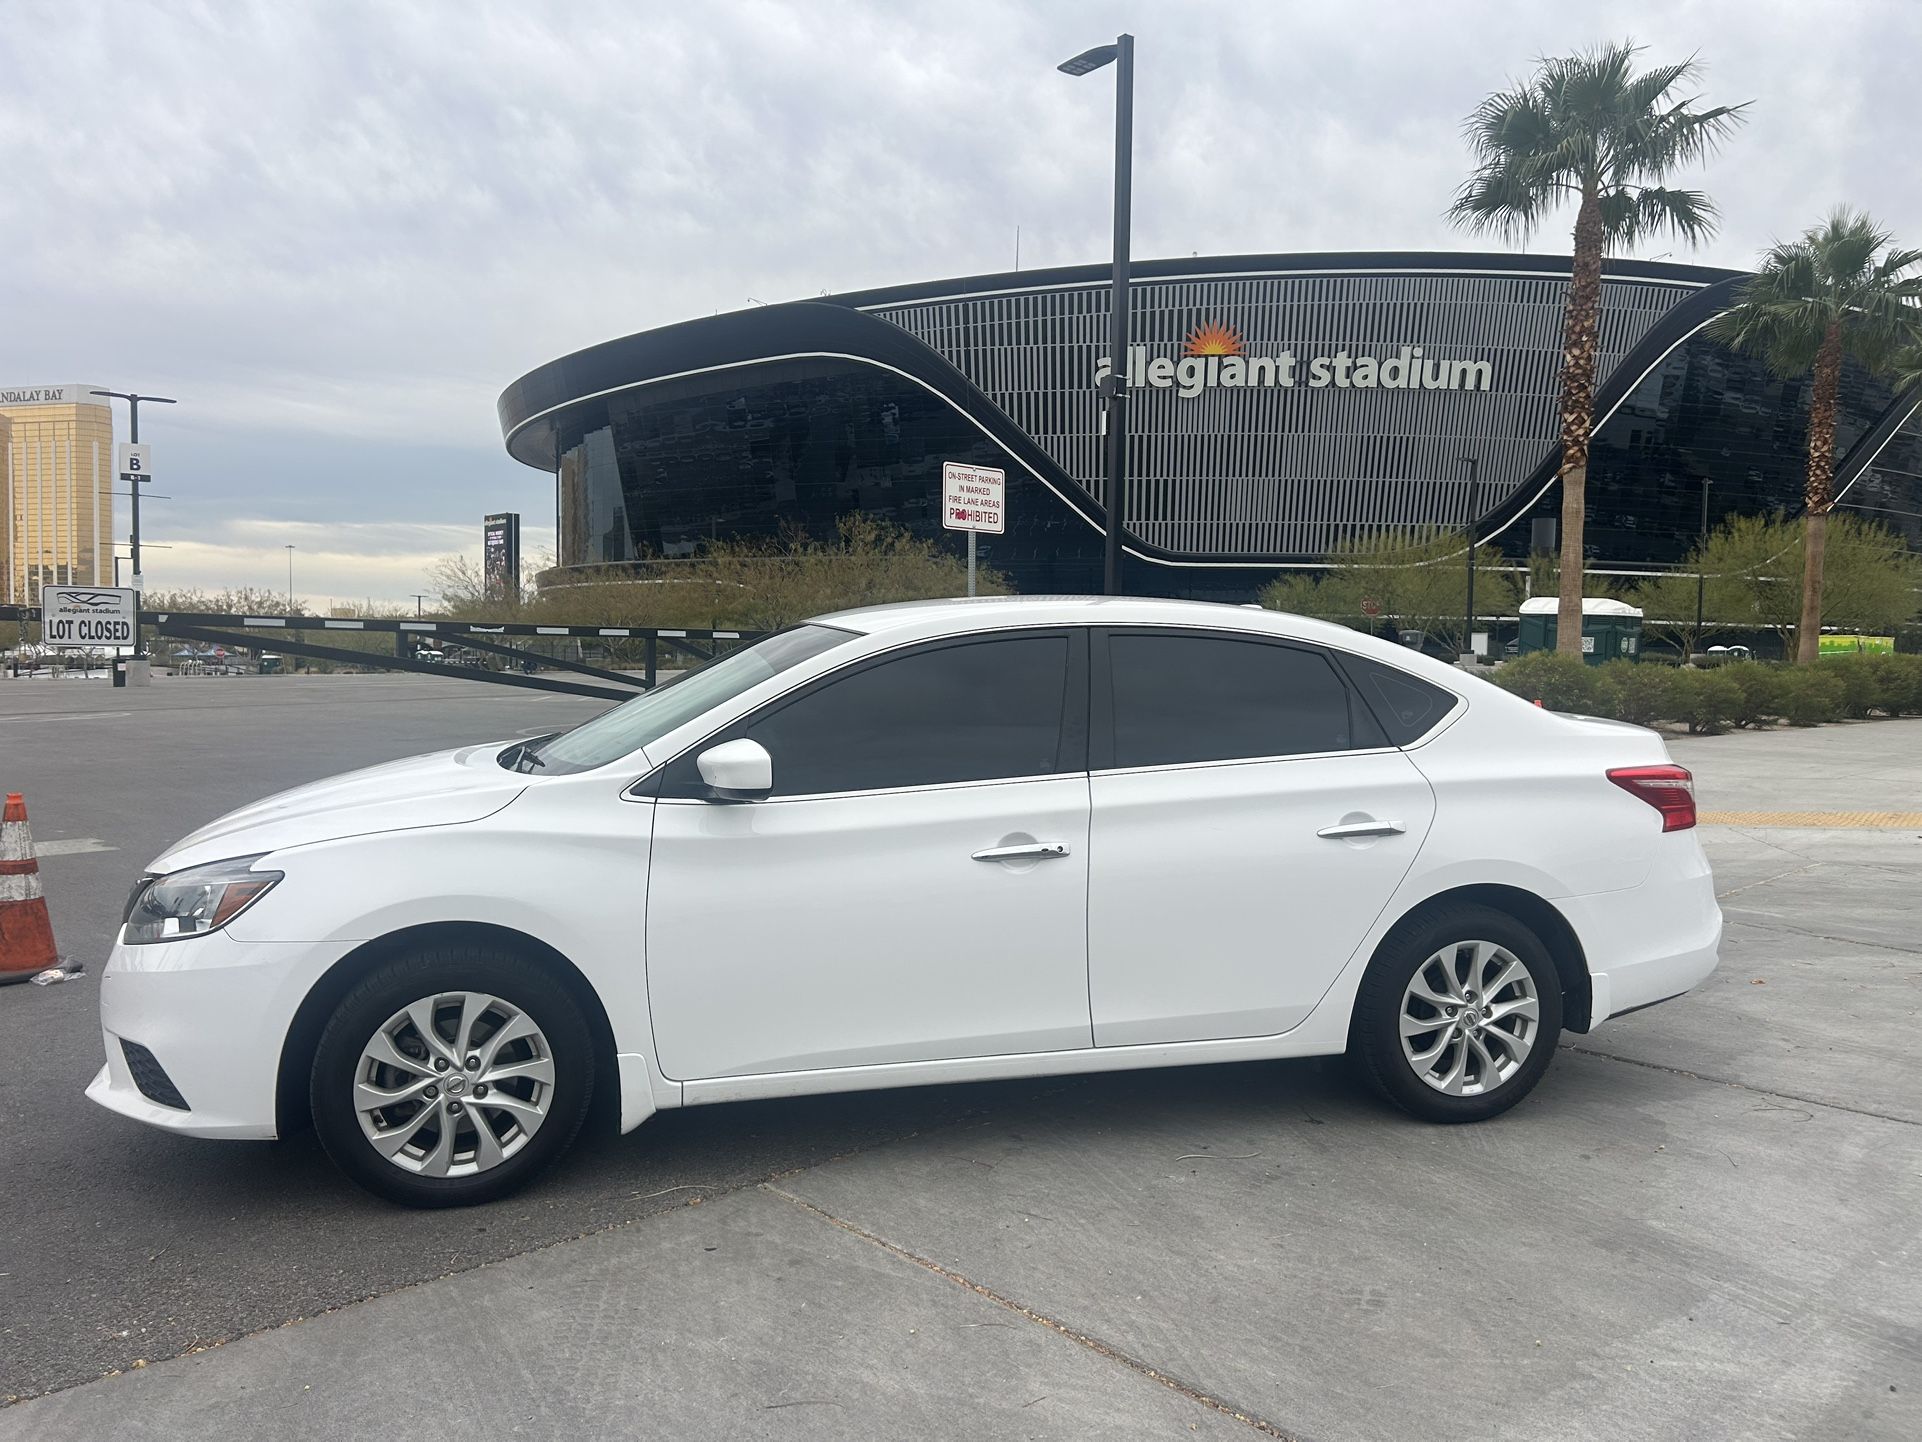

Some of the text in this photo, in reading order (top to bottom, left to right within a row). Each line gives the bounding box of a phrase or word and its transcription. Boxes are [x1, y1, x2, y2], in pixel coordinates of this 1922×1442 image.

[1095, 346, 1492, 398] allegiant stadium
[0, 389, 64, 403] NDALAY BAY
[129, 457, 141, 471] B
[948, 471, 1001, 485] ON-STREET PARKING
[959, 484, 990, 495] IN MARKED
[948, 495, 1000, 508] FIRE LANE AREAS
[949, 507, 998, 524] PROHIBITED
[49, 619, 130, 640] LOT CLOSED
